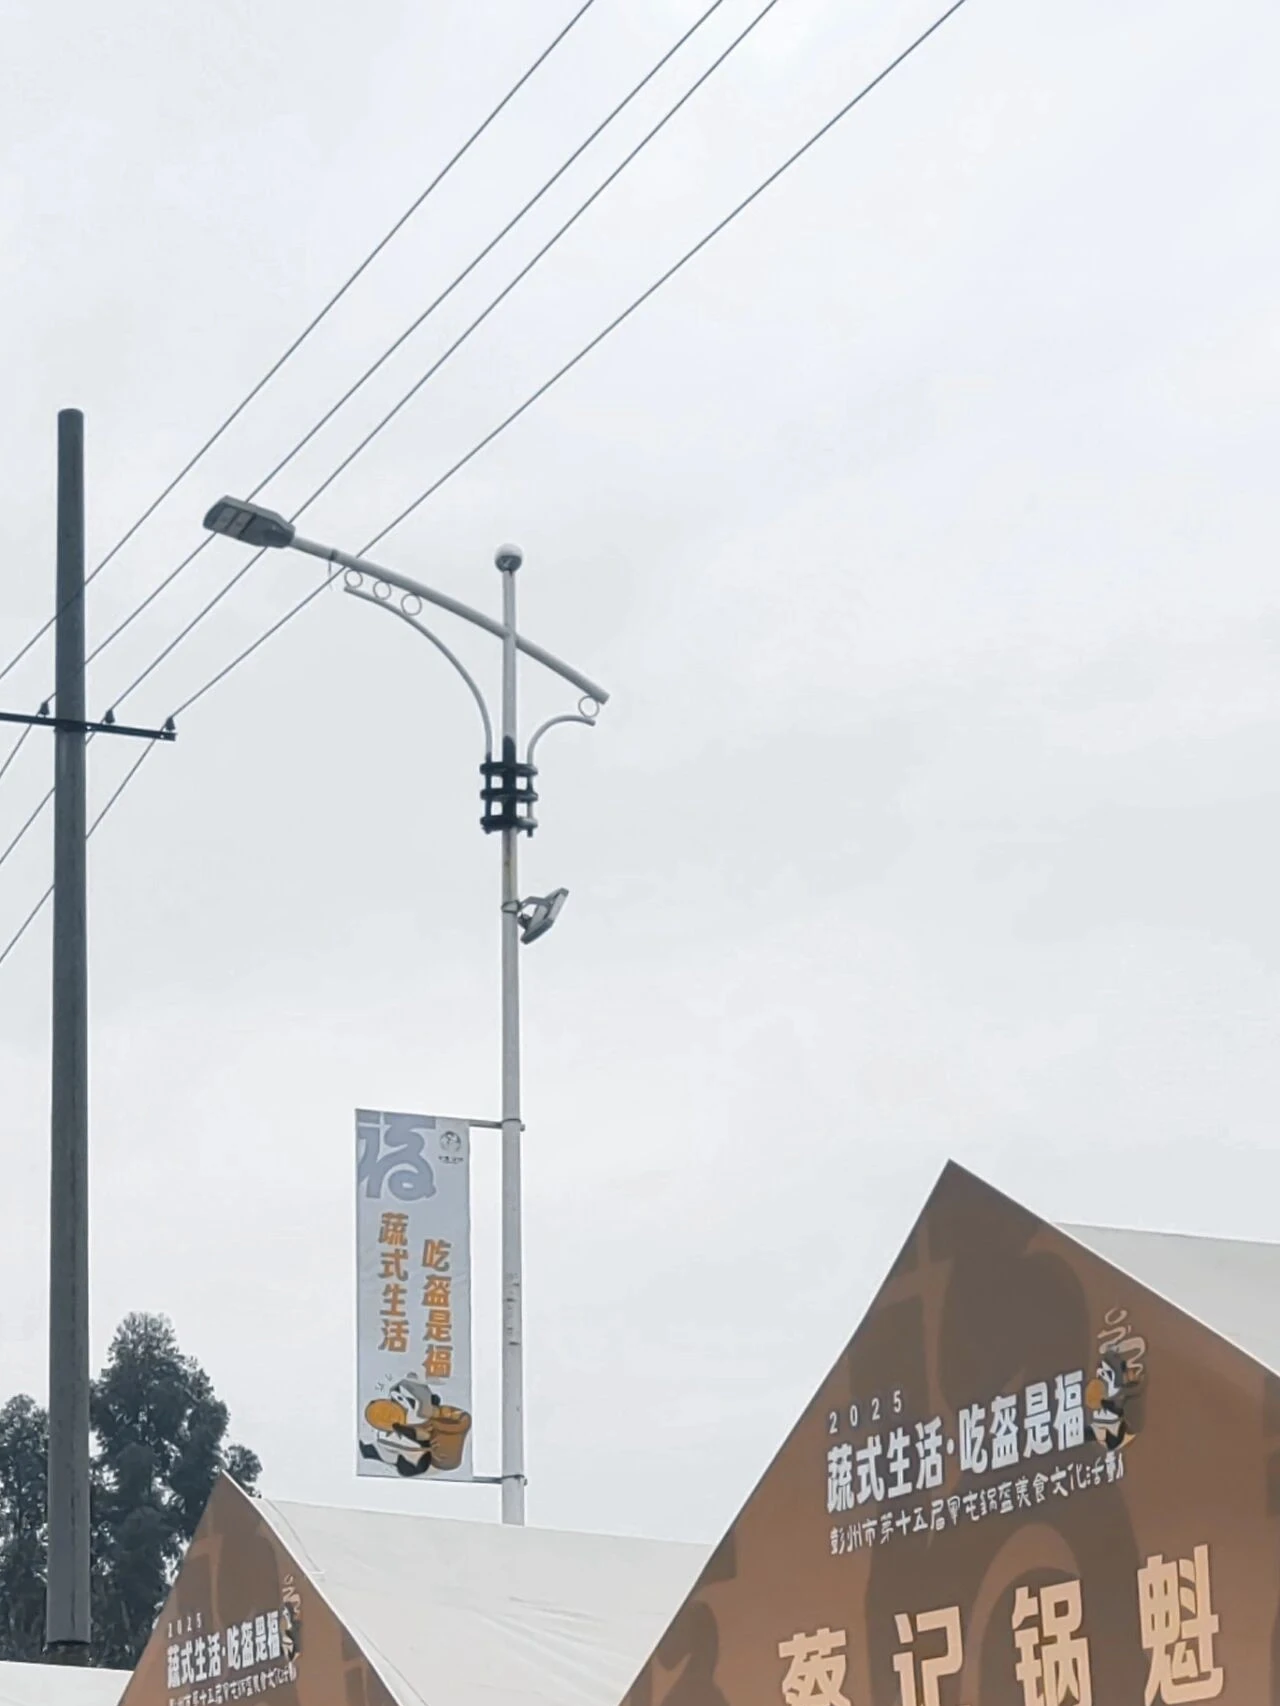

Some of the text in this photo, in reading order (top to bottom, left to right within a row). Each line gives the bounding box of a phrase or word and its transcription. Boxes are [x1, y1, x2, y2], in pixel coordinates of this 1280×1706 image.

[377, 1211, 410, 1352] 蔬式生活
[421, 1238, 452, 1380] 吃盔是福
[829, 1390, 902, 1434] 2025
